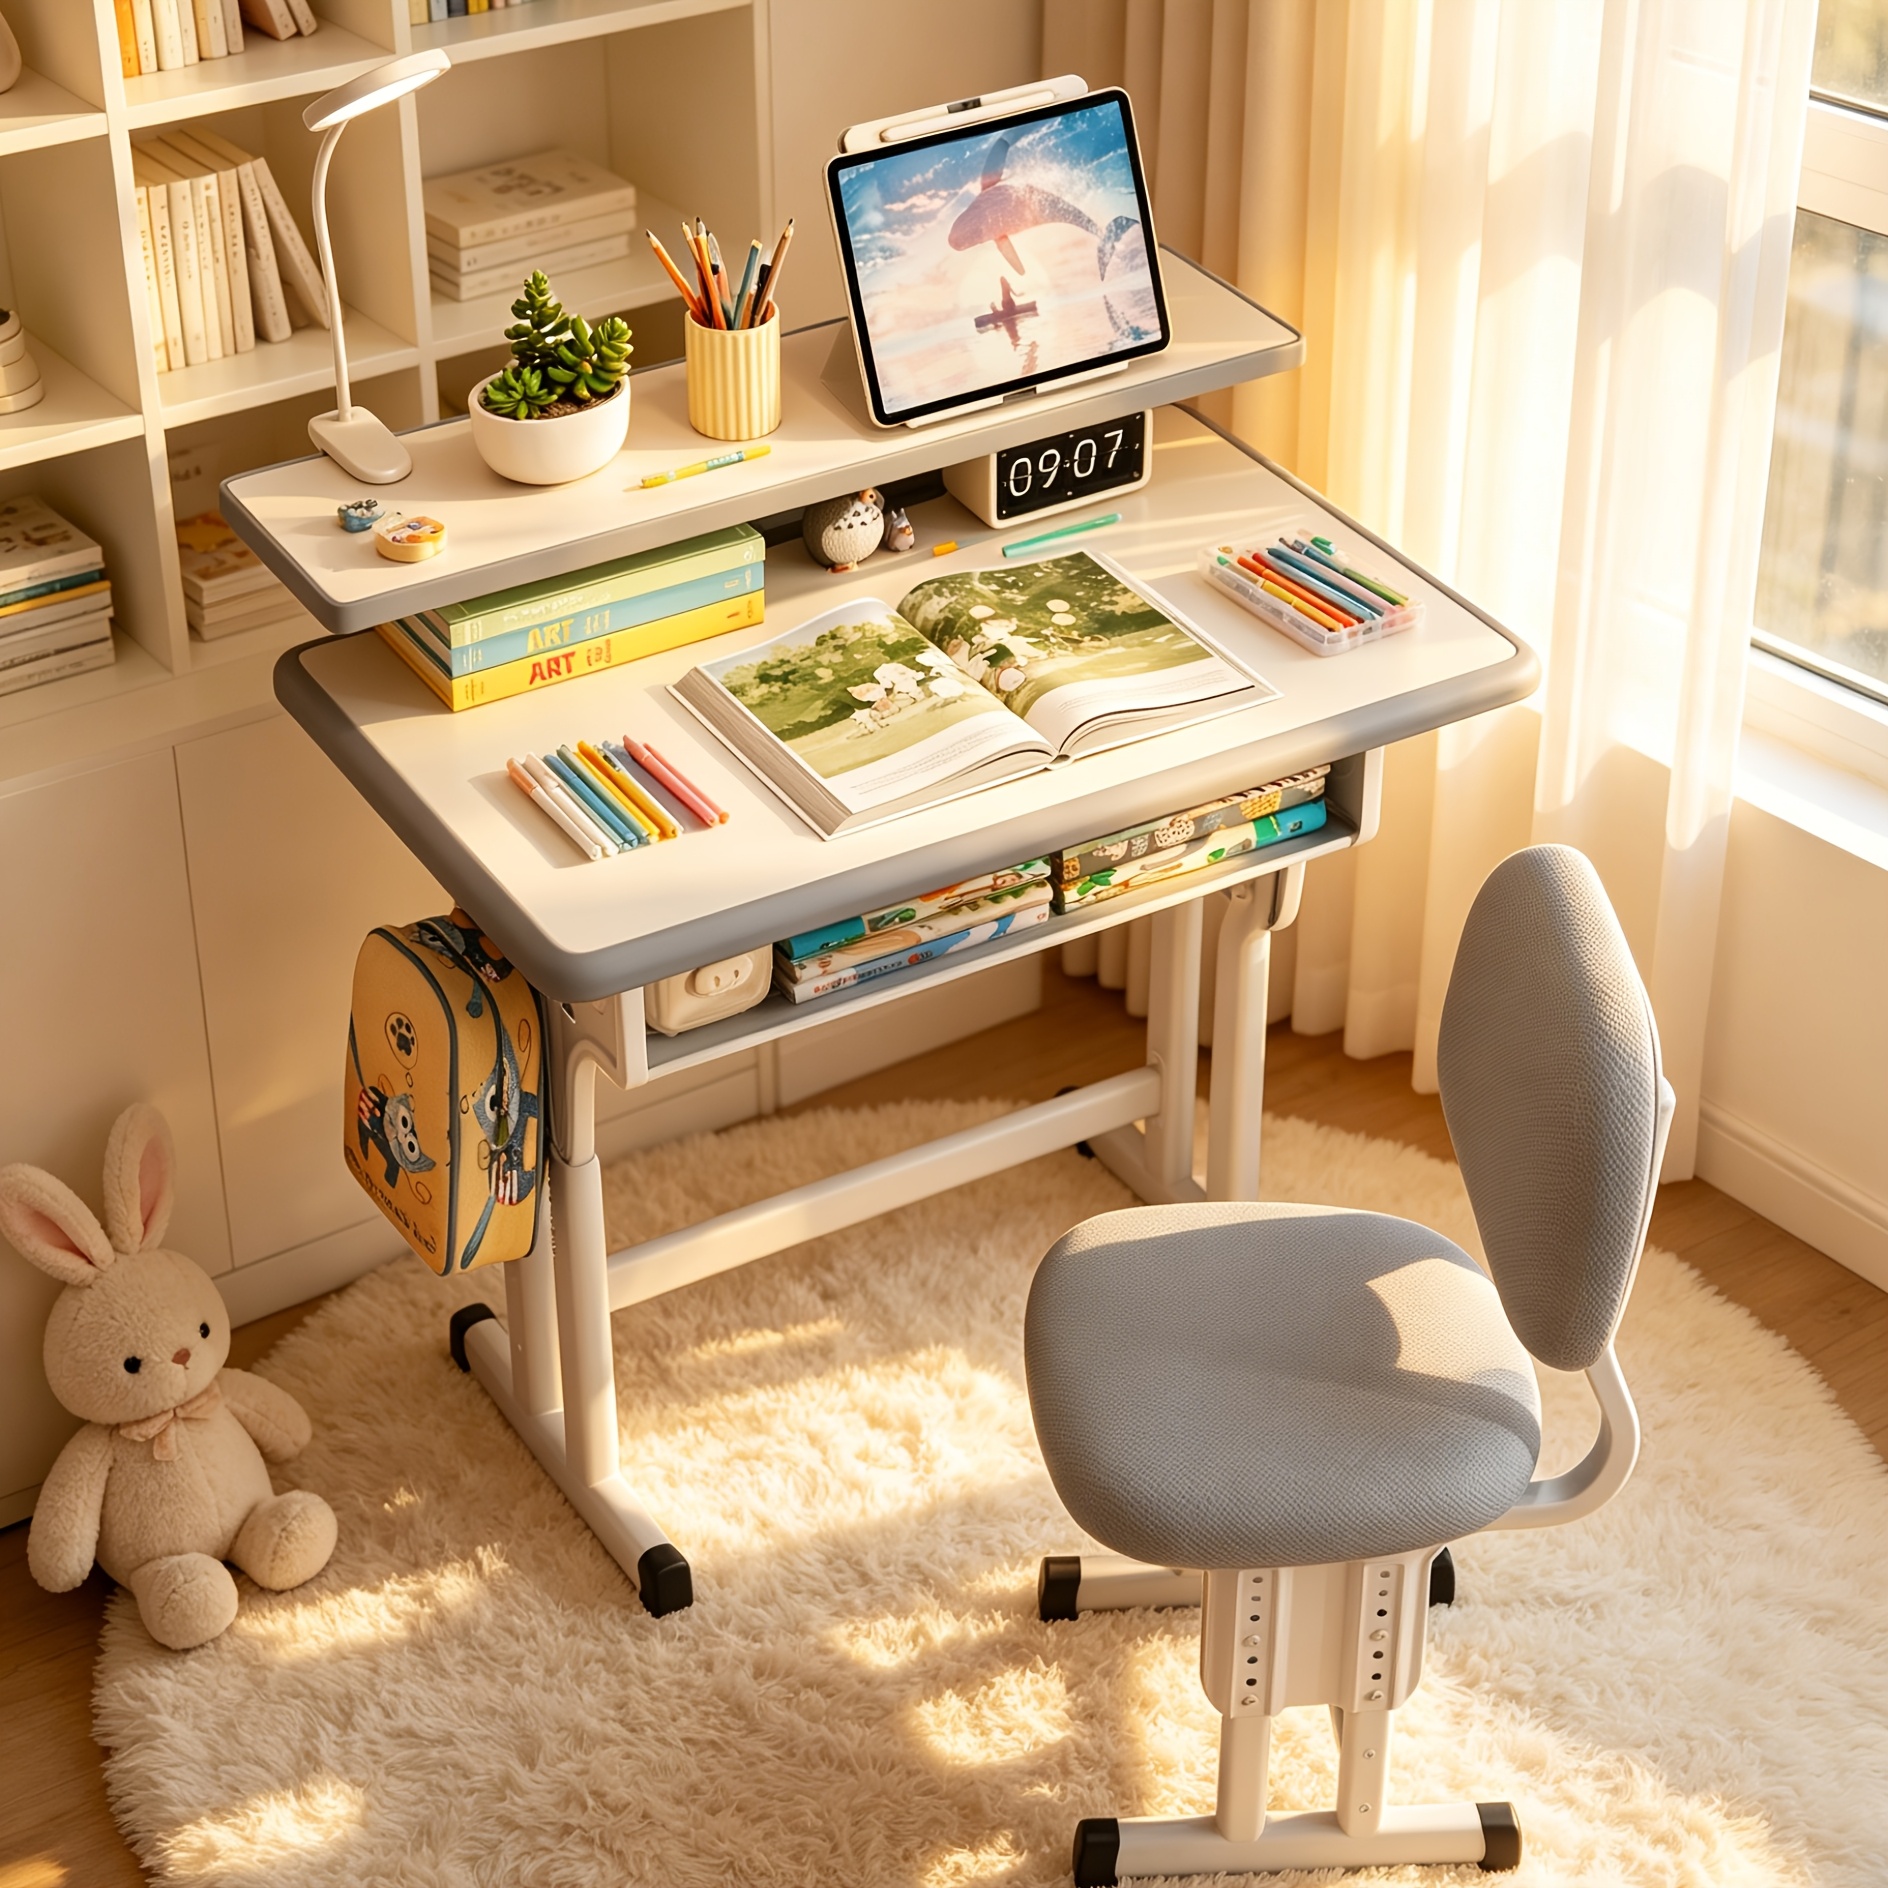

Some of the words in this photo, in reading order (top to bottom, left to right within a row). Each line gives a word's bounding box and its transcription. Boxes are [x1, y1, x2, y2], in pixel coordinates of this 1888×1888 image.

[1009, 429, 1123, 497] 09:07
[527, 618, 575, 654] ART
[529, 651, 576, 685] ART
